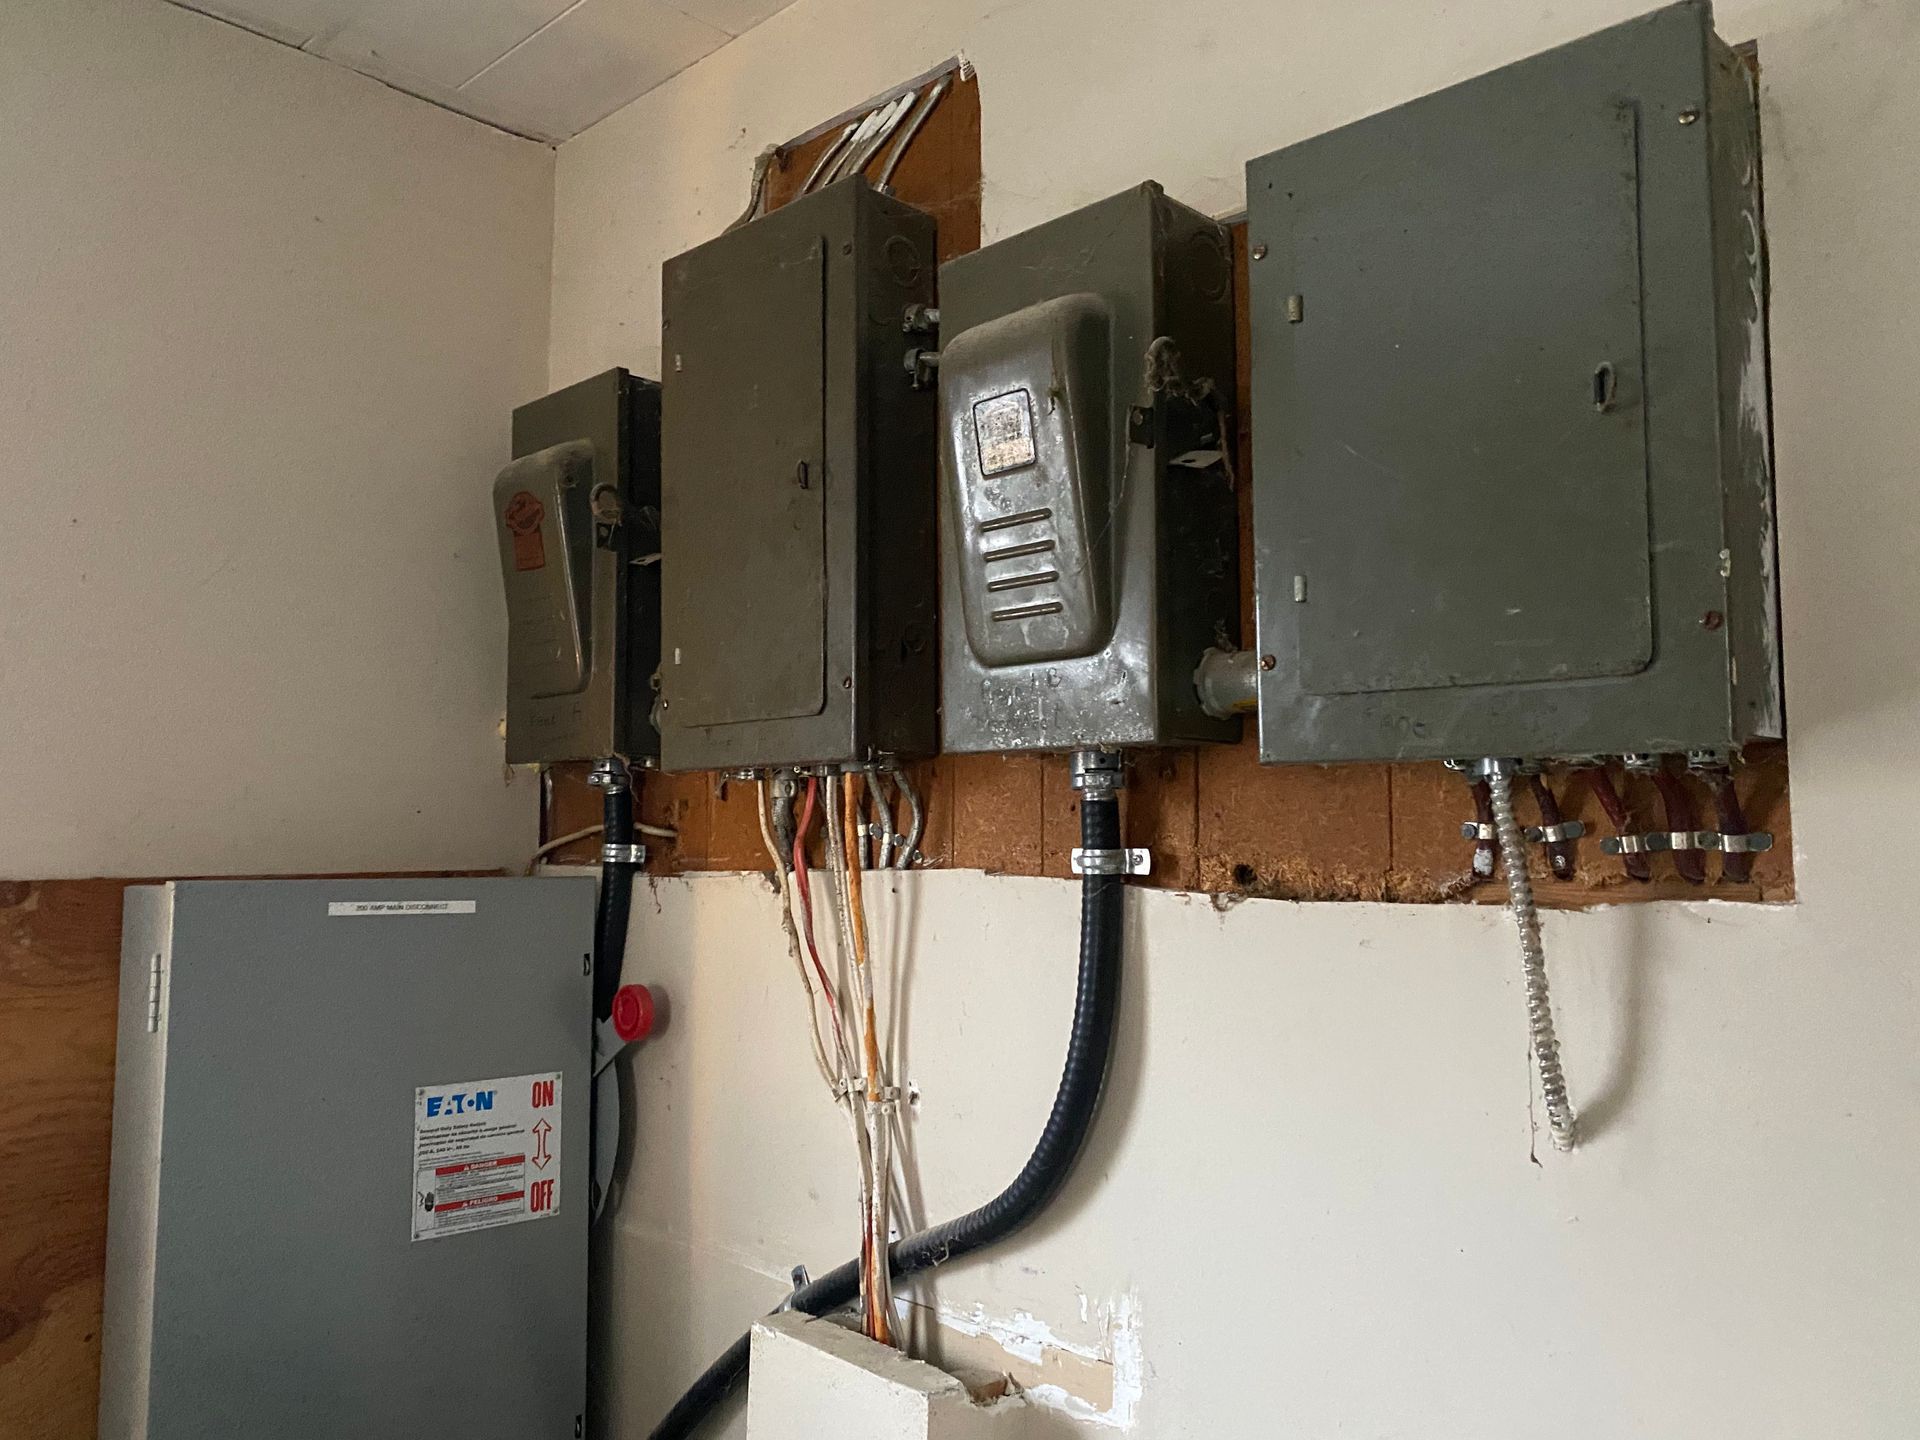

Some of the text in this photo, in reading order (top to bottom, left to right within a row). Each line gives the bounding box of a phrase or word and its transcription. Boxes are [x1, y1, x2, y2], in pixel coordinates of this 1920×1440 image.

[386, 903, 404, 911] MAIN
[427, 1091, 493, 1117] EATON
[532, 1080, 554, 1108] ON
[471, 1161, 498, 1170] DANGER
[530, 1179, 555, 1213] OFF
